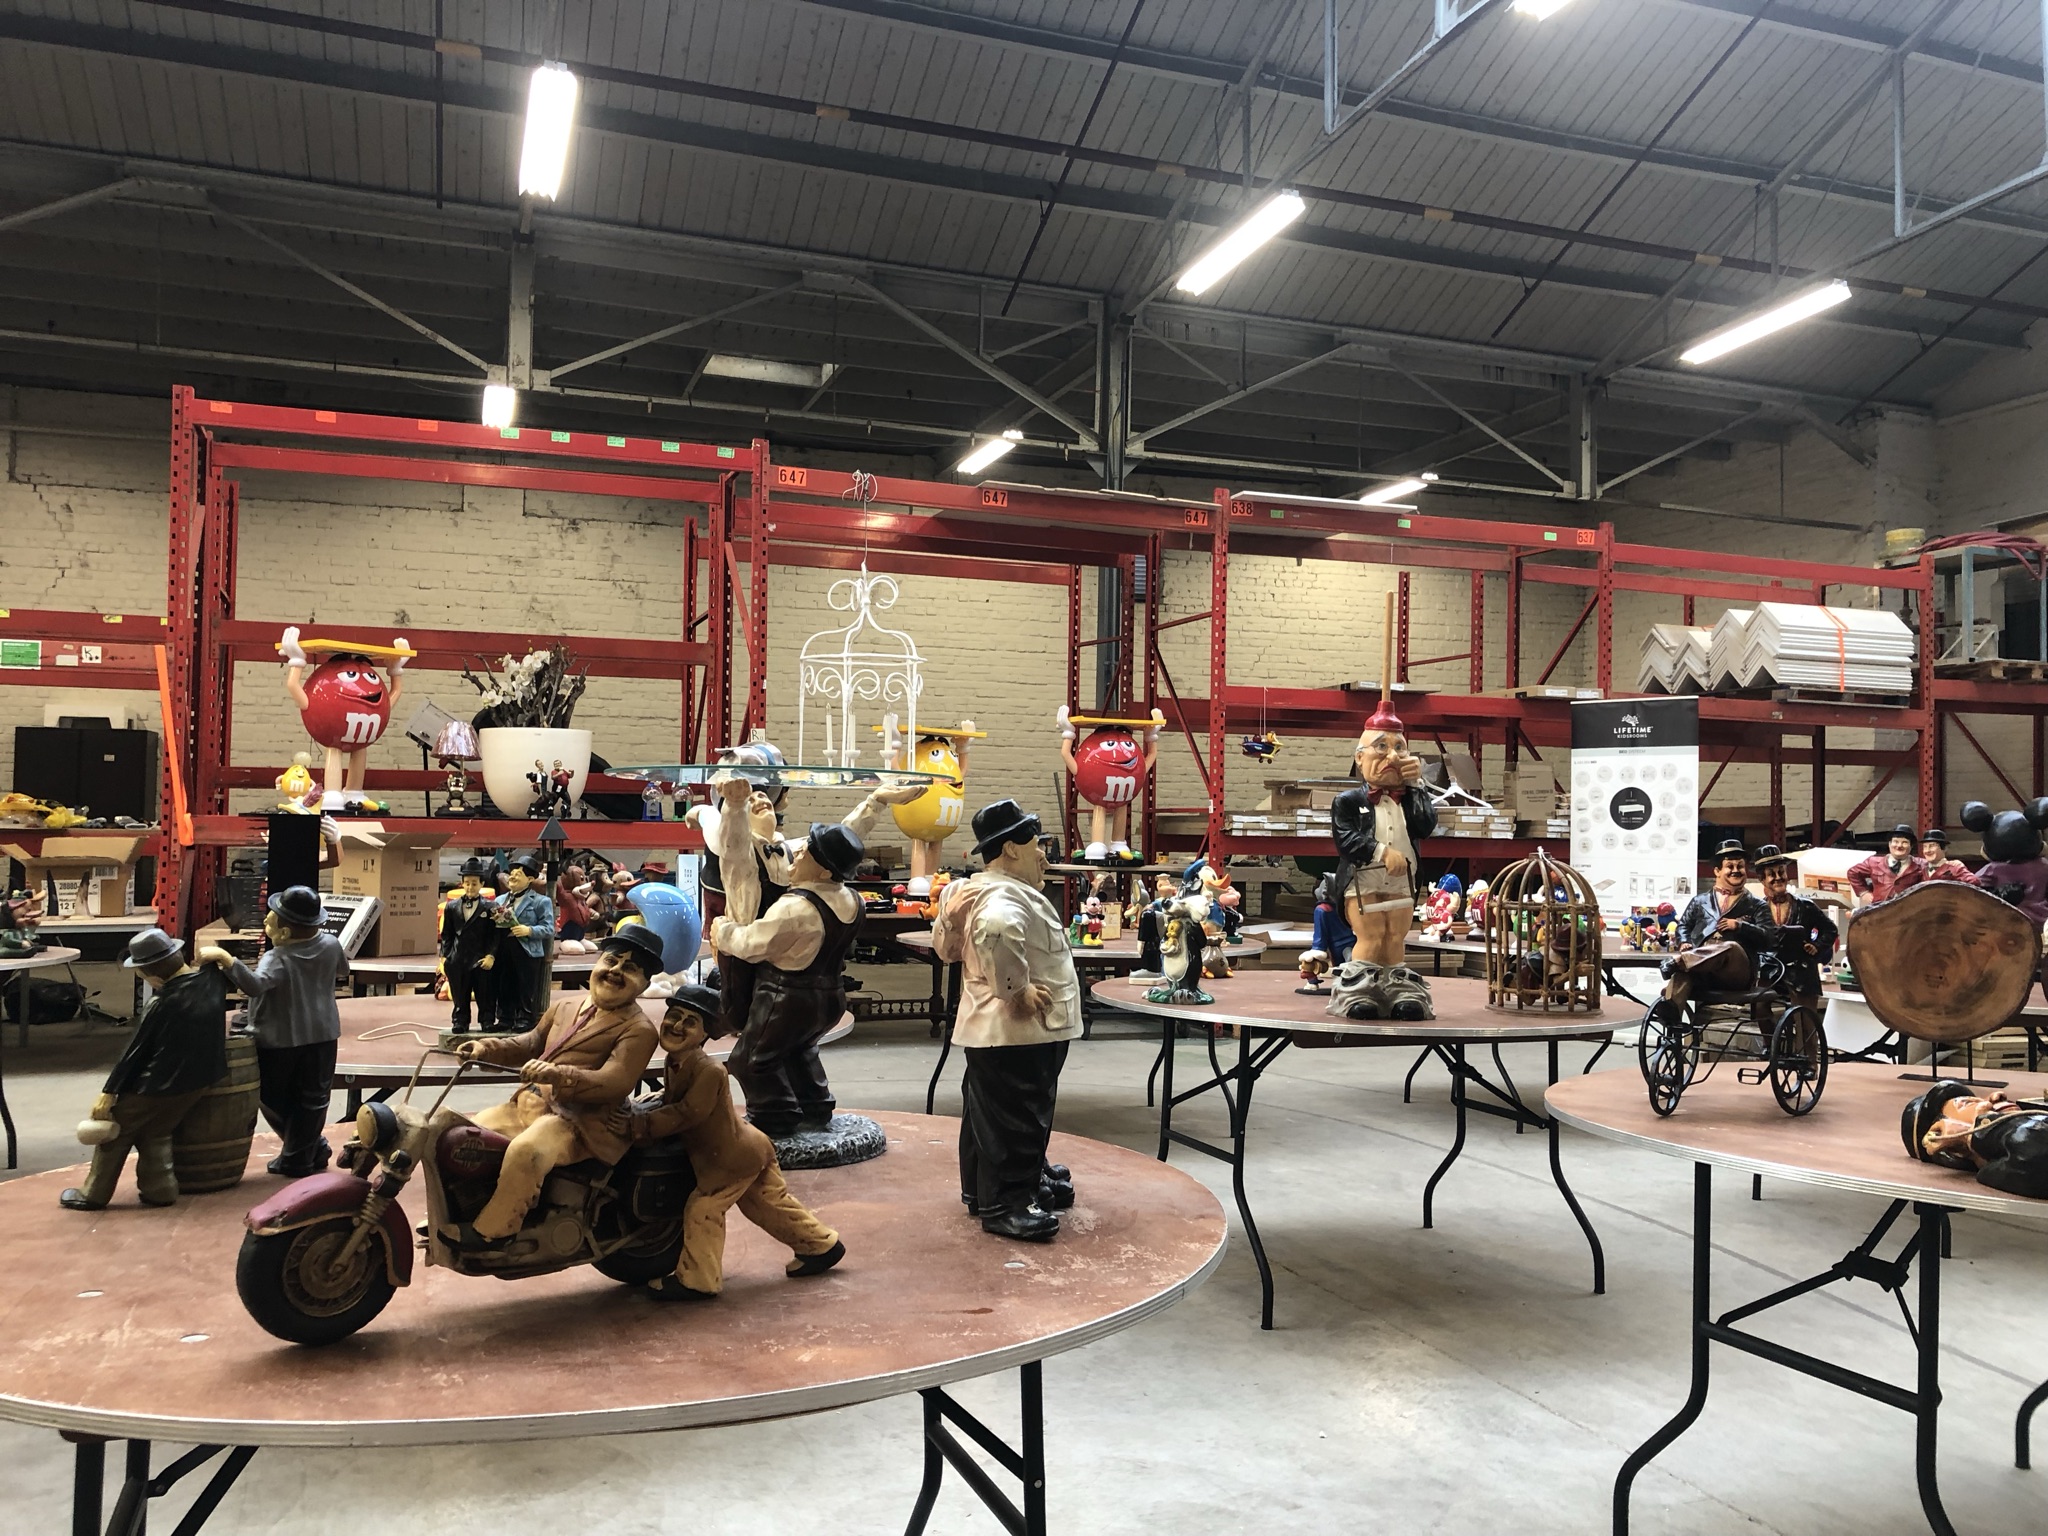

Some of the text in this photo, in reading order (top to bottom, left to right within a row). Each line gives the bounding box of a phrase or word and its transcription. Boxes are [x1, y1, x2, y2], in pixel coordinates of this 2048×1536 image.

[780, 469, 805, 484] 647
[983, 490, 1006, 505] 647
[1231, 502, 1253, 516] 638
[1185, 510, 1207, 524] 647
[1578, 531, 1593, 543] 637
[1613, 726, 1652, 734] LIFETIME
